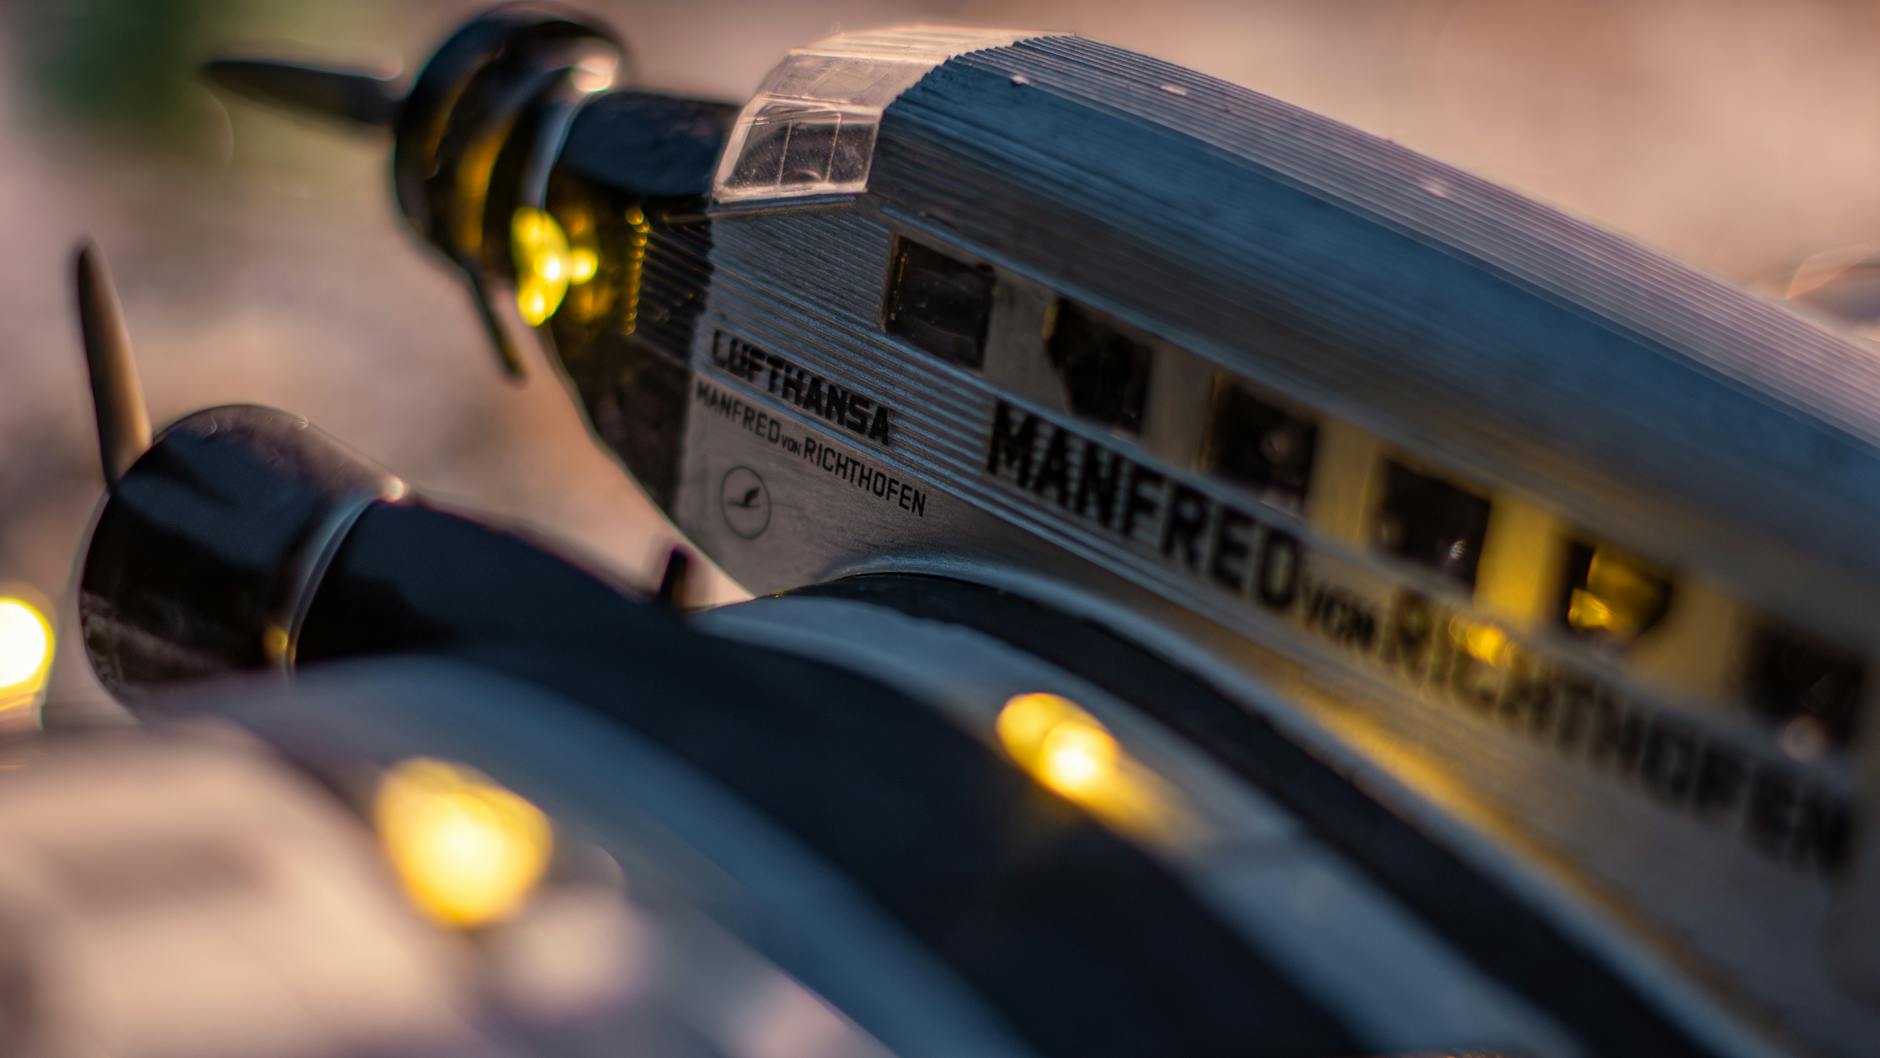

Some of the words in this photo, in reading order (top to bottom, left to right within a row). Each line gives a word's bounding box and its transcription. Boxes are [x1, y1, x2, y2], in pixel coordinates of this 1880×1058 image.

[694, 380, 781, 445] MANFRED
[780, 434, 801, 457] VON
[803, 436, 927, 518] RICHTHOFEN
[711, 328, 893, 446] LUFTHANSA
[987, 399, 1301, 609] MANFRED
[1303, 581, 1376, 651] VON
[1382, 587, 1854, 872] RICHTHOFEN
